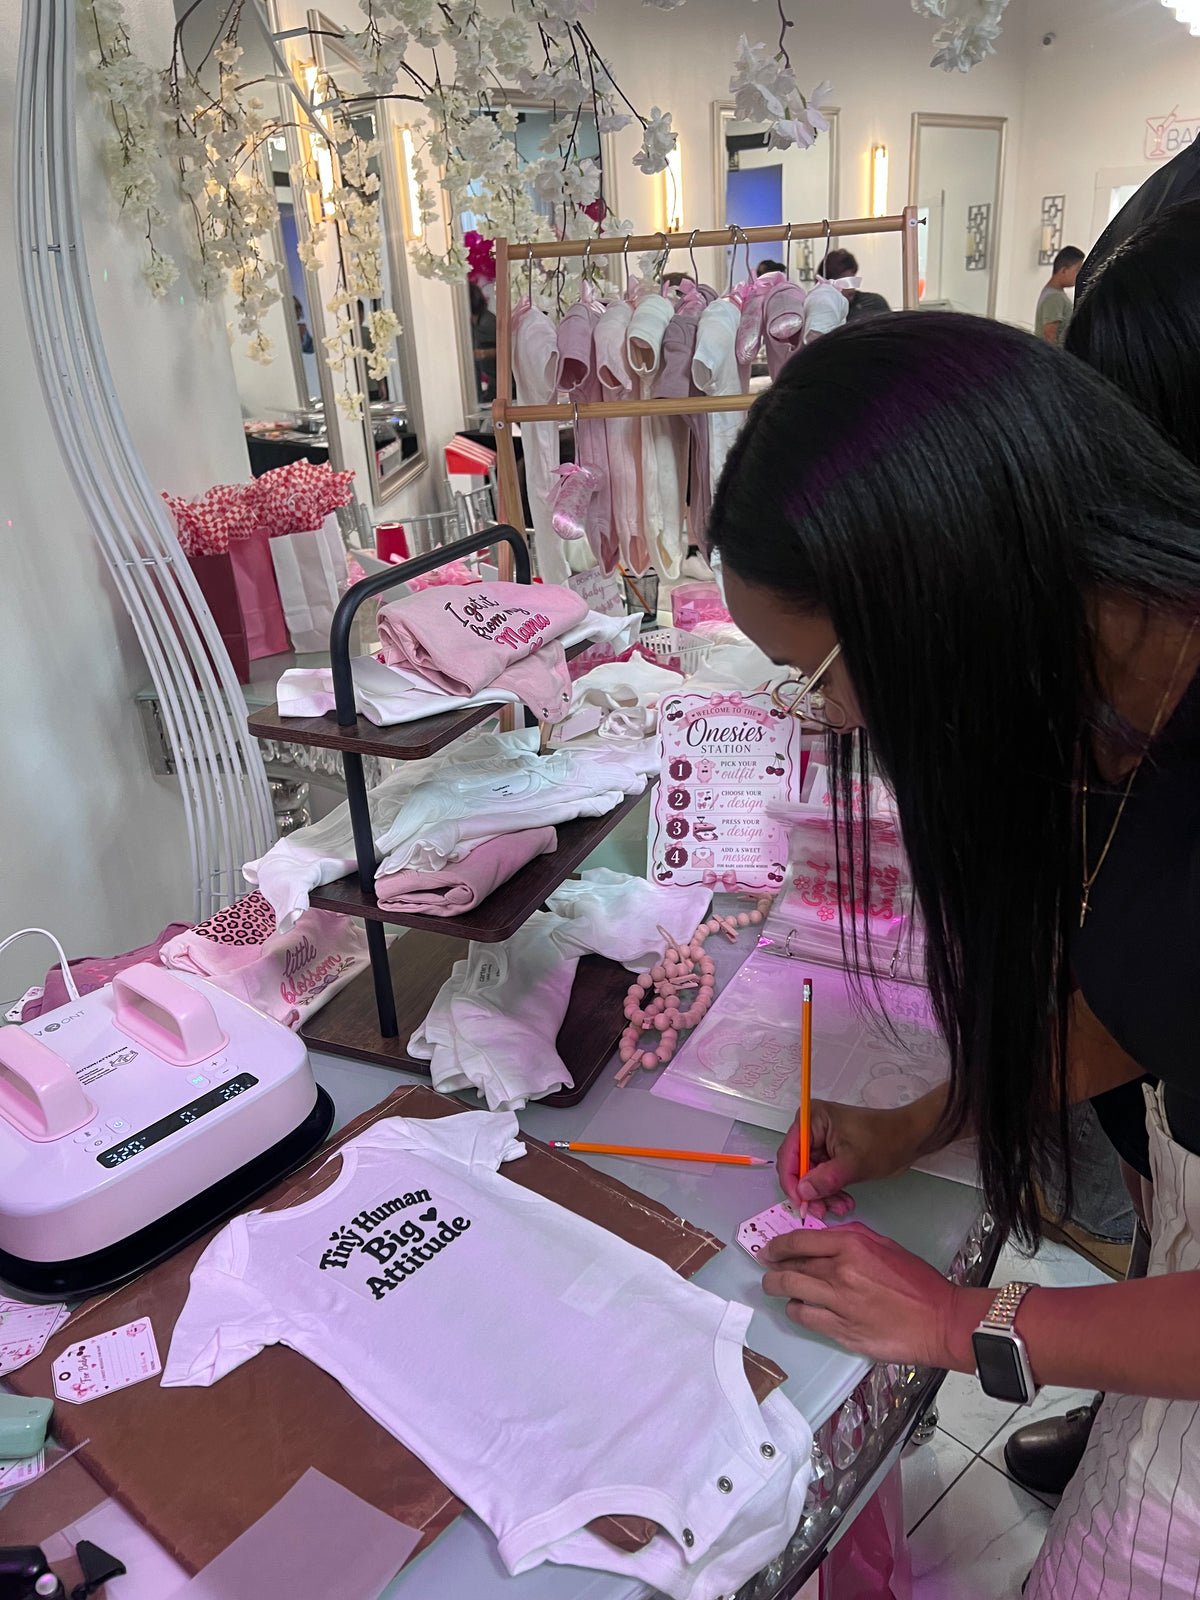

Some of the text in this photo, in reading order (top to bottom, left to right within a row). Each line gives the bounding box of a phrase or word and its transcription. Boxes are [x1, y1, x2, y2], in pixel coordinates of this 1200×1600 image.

[444, 602, 469, 628] I
[470, 607, 531, 640] from my
[494, 613, 551, 650] Mama
[695, 706, 730, 717] WELCOME
[743, 708, 757, 717] THE
[686, 717, 767, 747] Onesies
[700, 744, 752, 754] STATION
[677, 763, 684, 777] 1
[721, 767, 755, 784] outfit
[674, 792, 684, 806] 2
[726, 796, 763, 813] design
[672, 821, 682, 836] 3
[726, 824, 763, 841] design
[670, 850, 680, 864] 4
[722, 853, 761, 865] message
[282, 935, 317, 978] little
[280, 954, 342, 1005] blossom
[219, 1083, 245, 1100] 20
[106, 1140, 145, 1166] 320
[319, 1189, 432, 1270] Tiny Human
[361, 1220, 425, 1265] Big
[366, 1216, 471, 1300] Attitude
[77, 1354, 91, 1373] Baby
